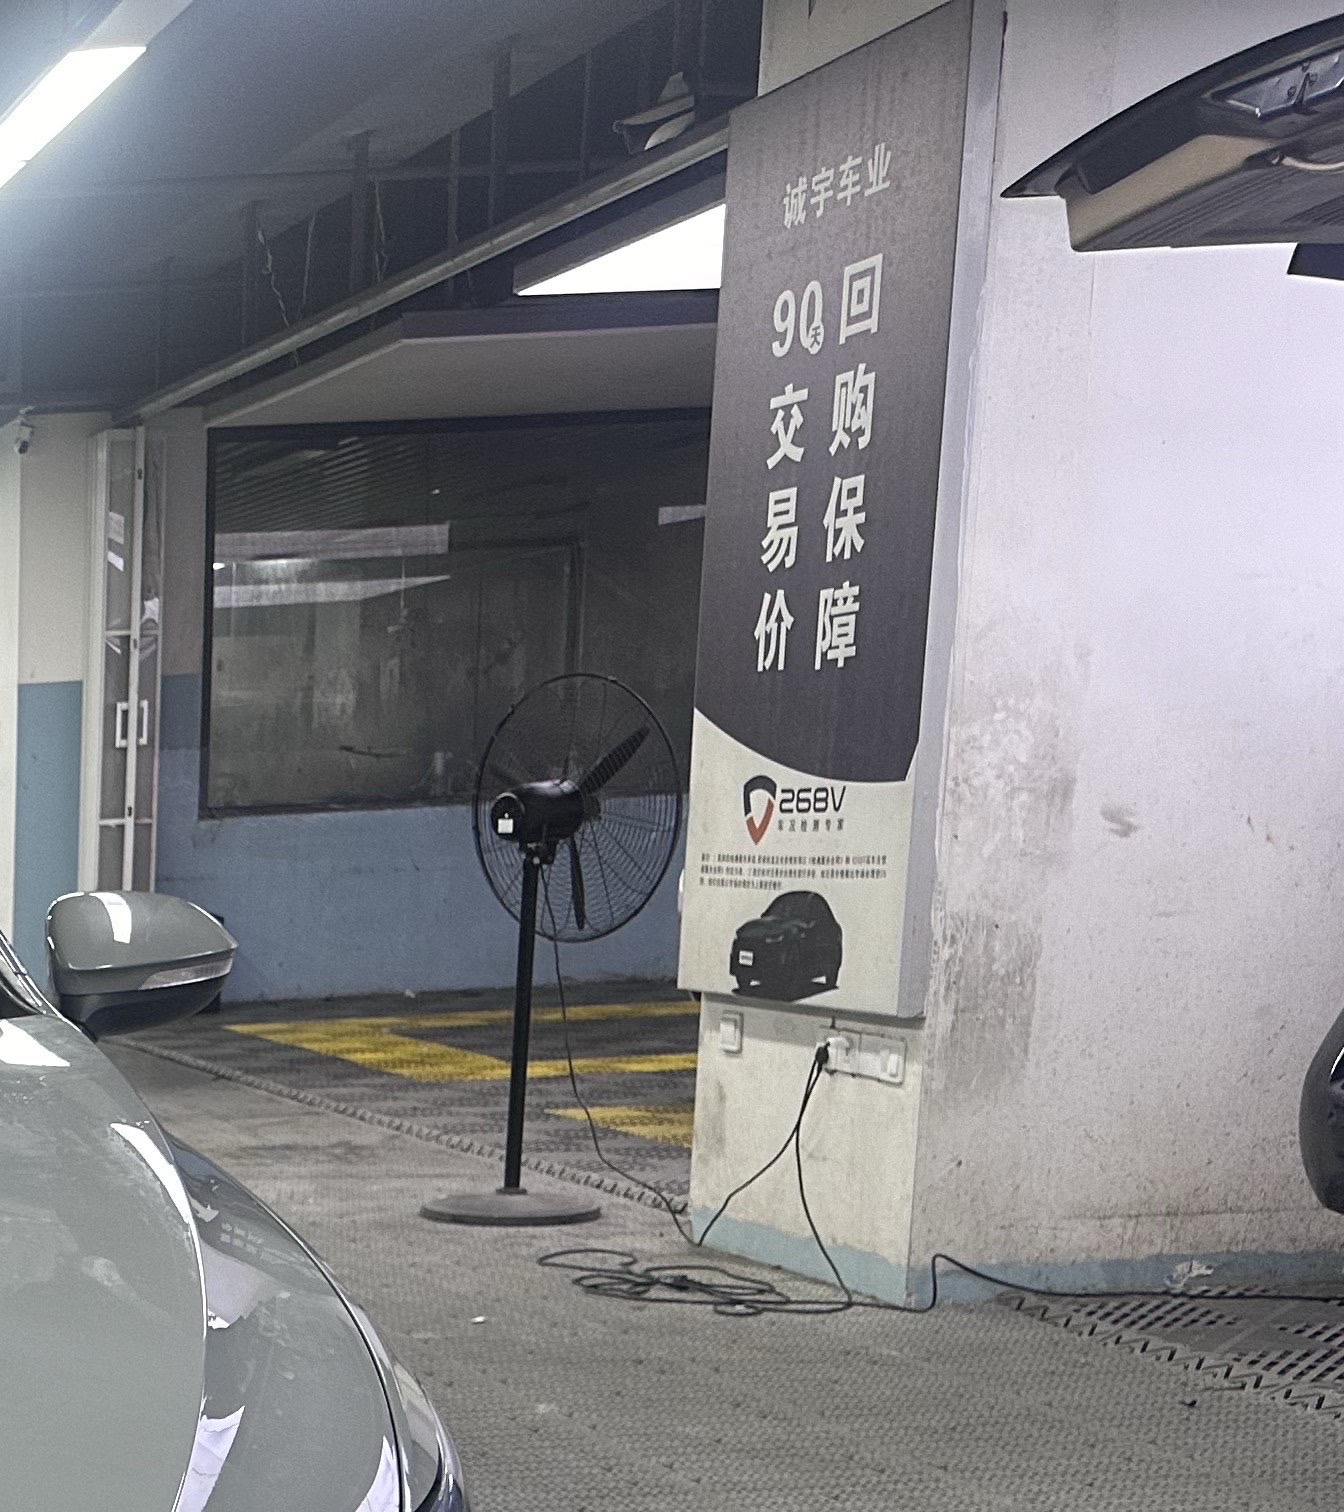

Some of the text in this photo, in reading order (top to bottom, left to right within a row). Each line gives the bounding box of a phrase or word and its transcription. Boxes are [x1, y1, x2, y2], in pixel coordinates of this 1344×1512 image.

[783, 142, 892, 229] 诚宇车业
[815, 253, 884, 670] 回购保障
[779, 786, 846, 814] 268V
